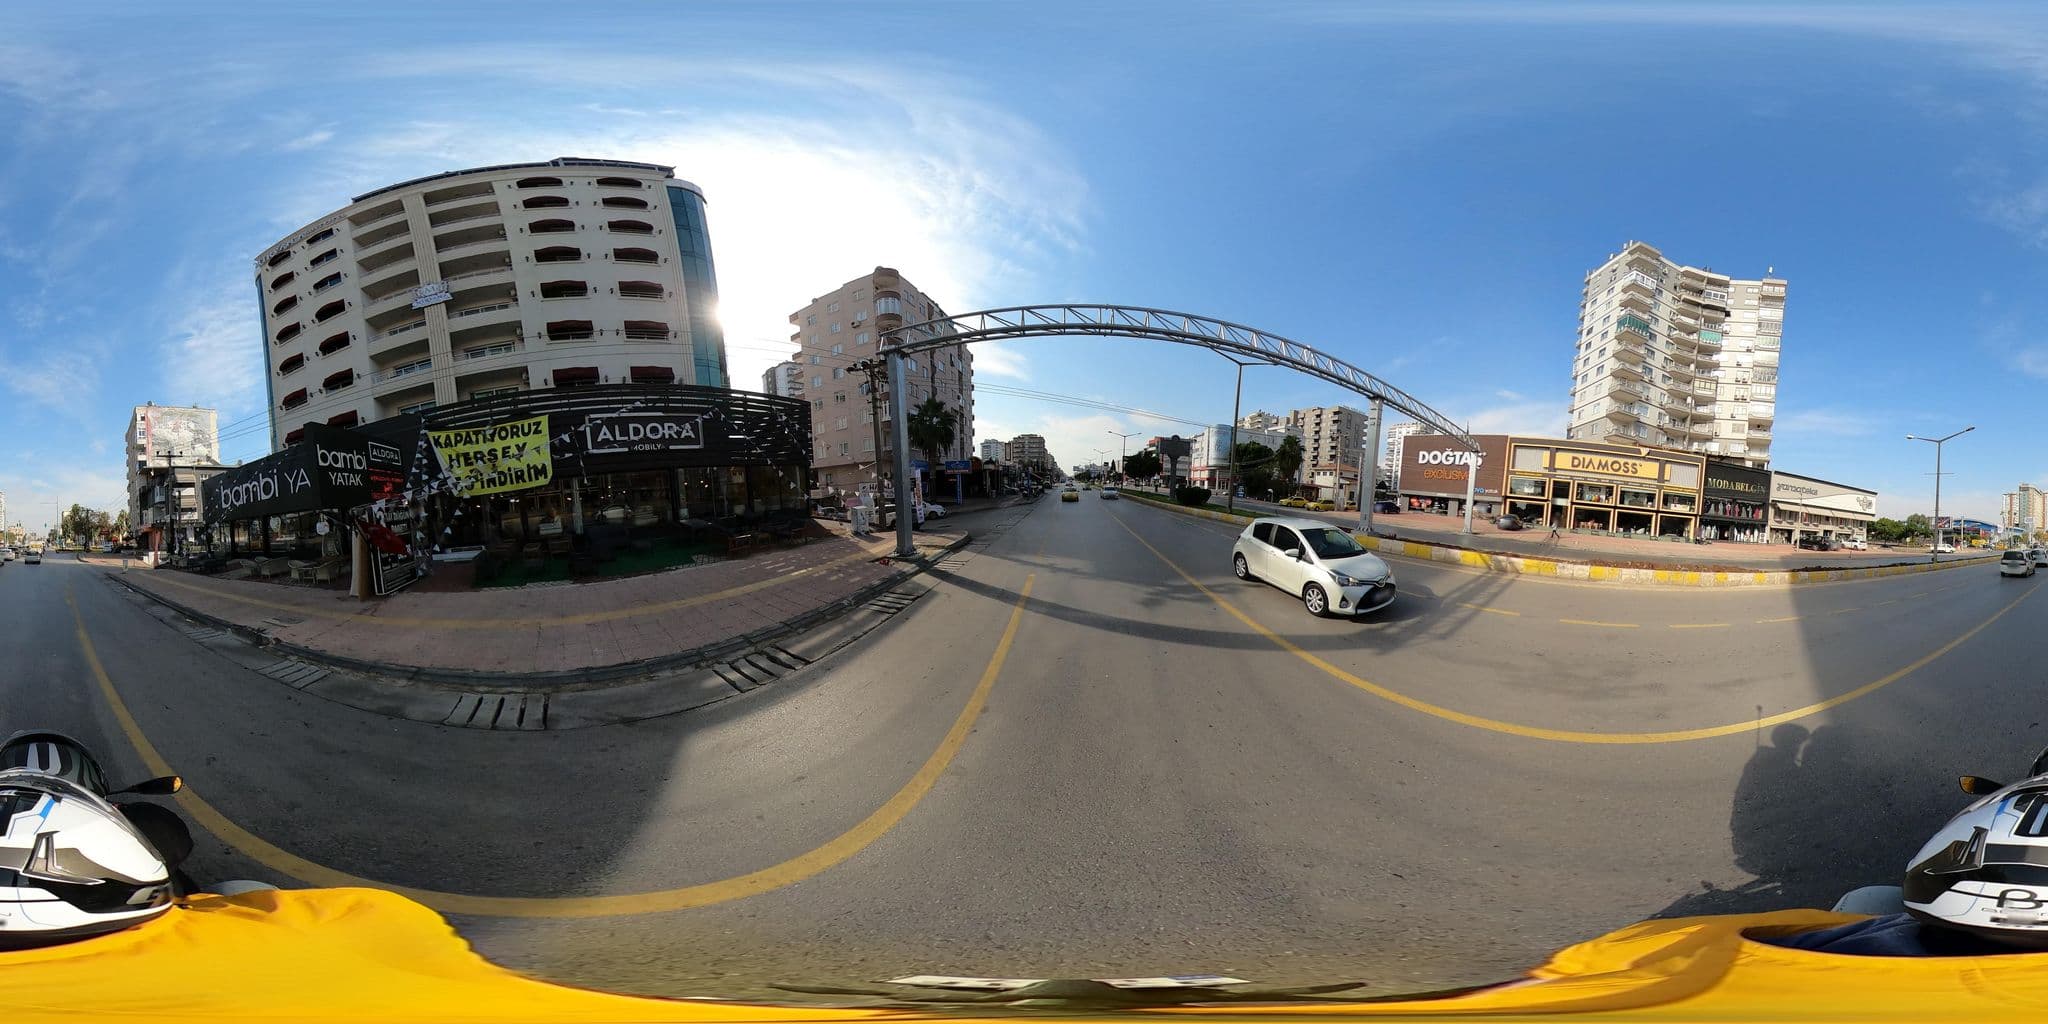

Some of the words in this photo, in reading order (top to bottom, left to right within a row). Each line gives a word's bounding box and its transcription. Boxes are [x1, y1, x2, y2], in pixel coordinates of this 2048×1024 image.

[432, 421, 542, 448] KAPATIYORUZ
[597, 422, 696, 441] ALDORA
[316, 444, 367, 470] bambi
[372, 450, 399, 461] ALDORA
[1570, 455, 1639, 475] DIAMOSS
[328, 471, 363, 487] YATAK
[1423, 467, 1469, 481] exclusiv
[220, 468, 279, 509] bambi
